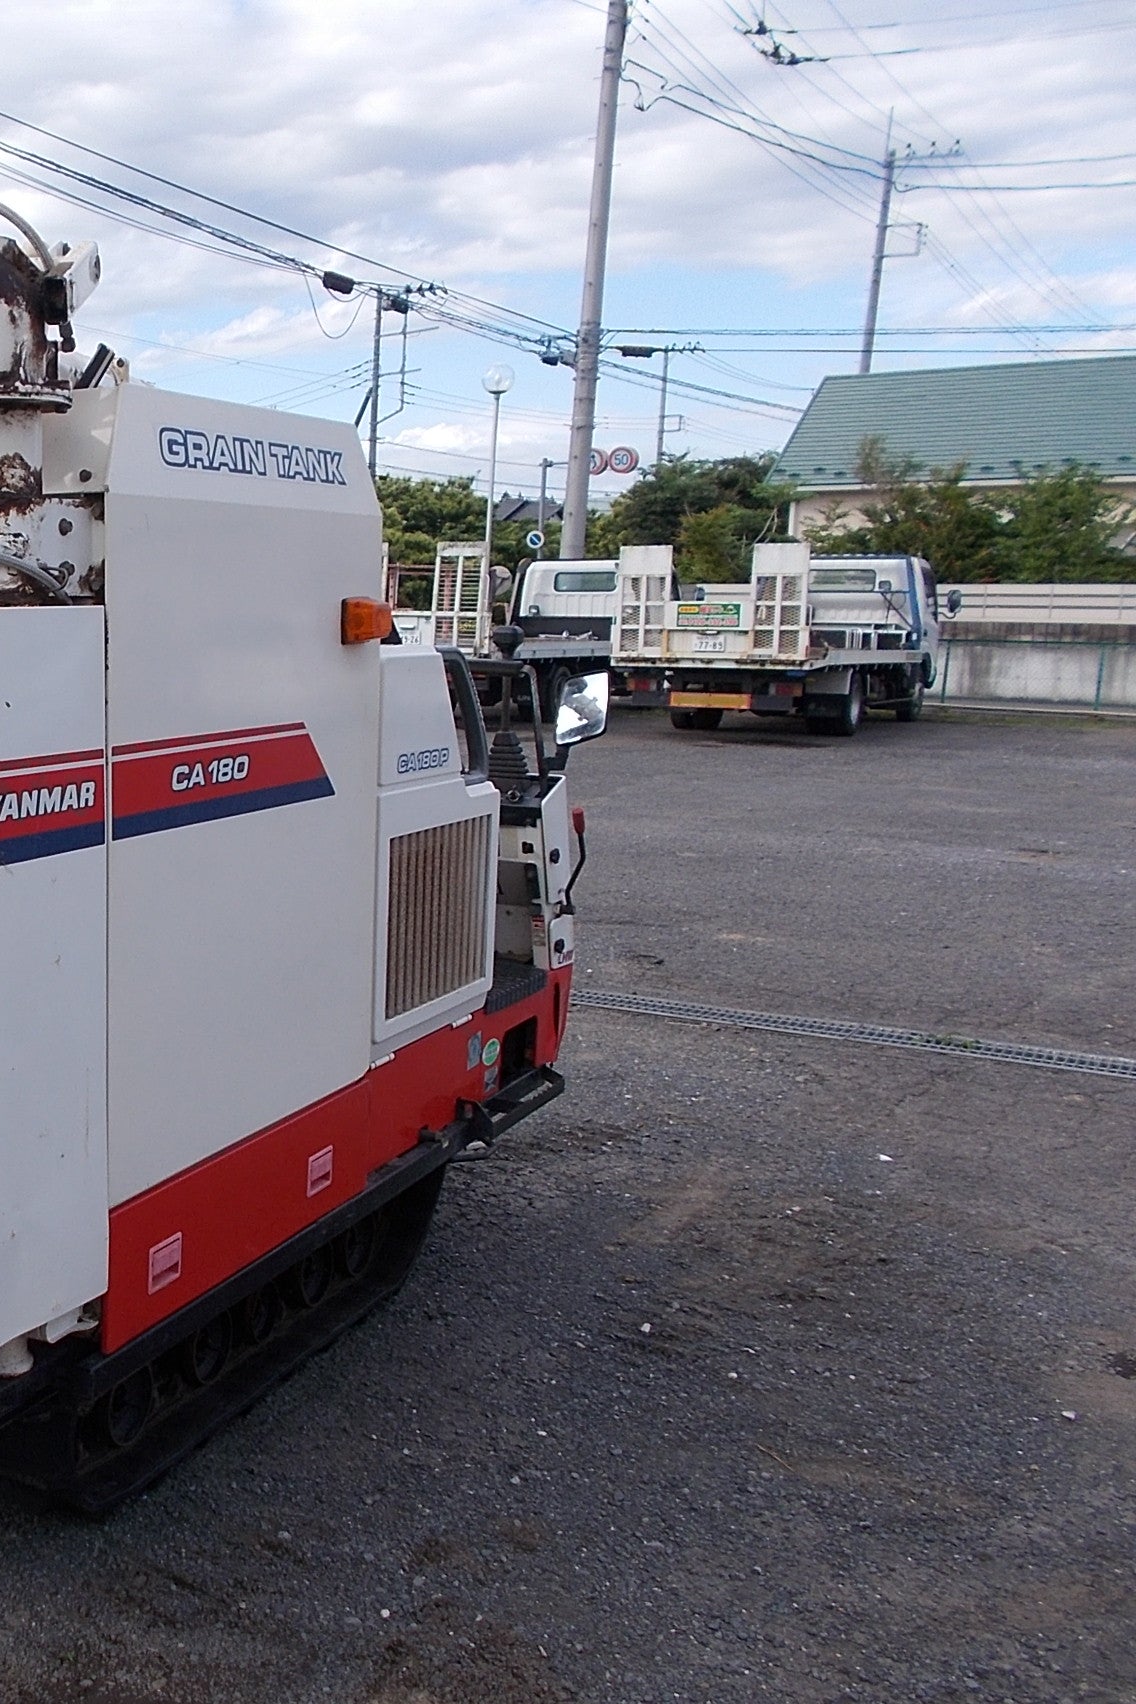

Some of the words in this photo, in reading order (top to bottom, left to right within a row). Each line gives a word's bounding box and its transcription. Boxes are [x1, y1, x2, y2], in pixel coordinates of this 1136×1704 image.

[159, 427, 267, 476] GRAIN
[268, 442, 347, 486] TANK
[614, 453, 629, 466] 50
